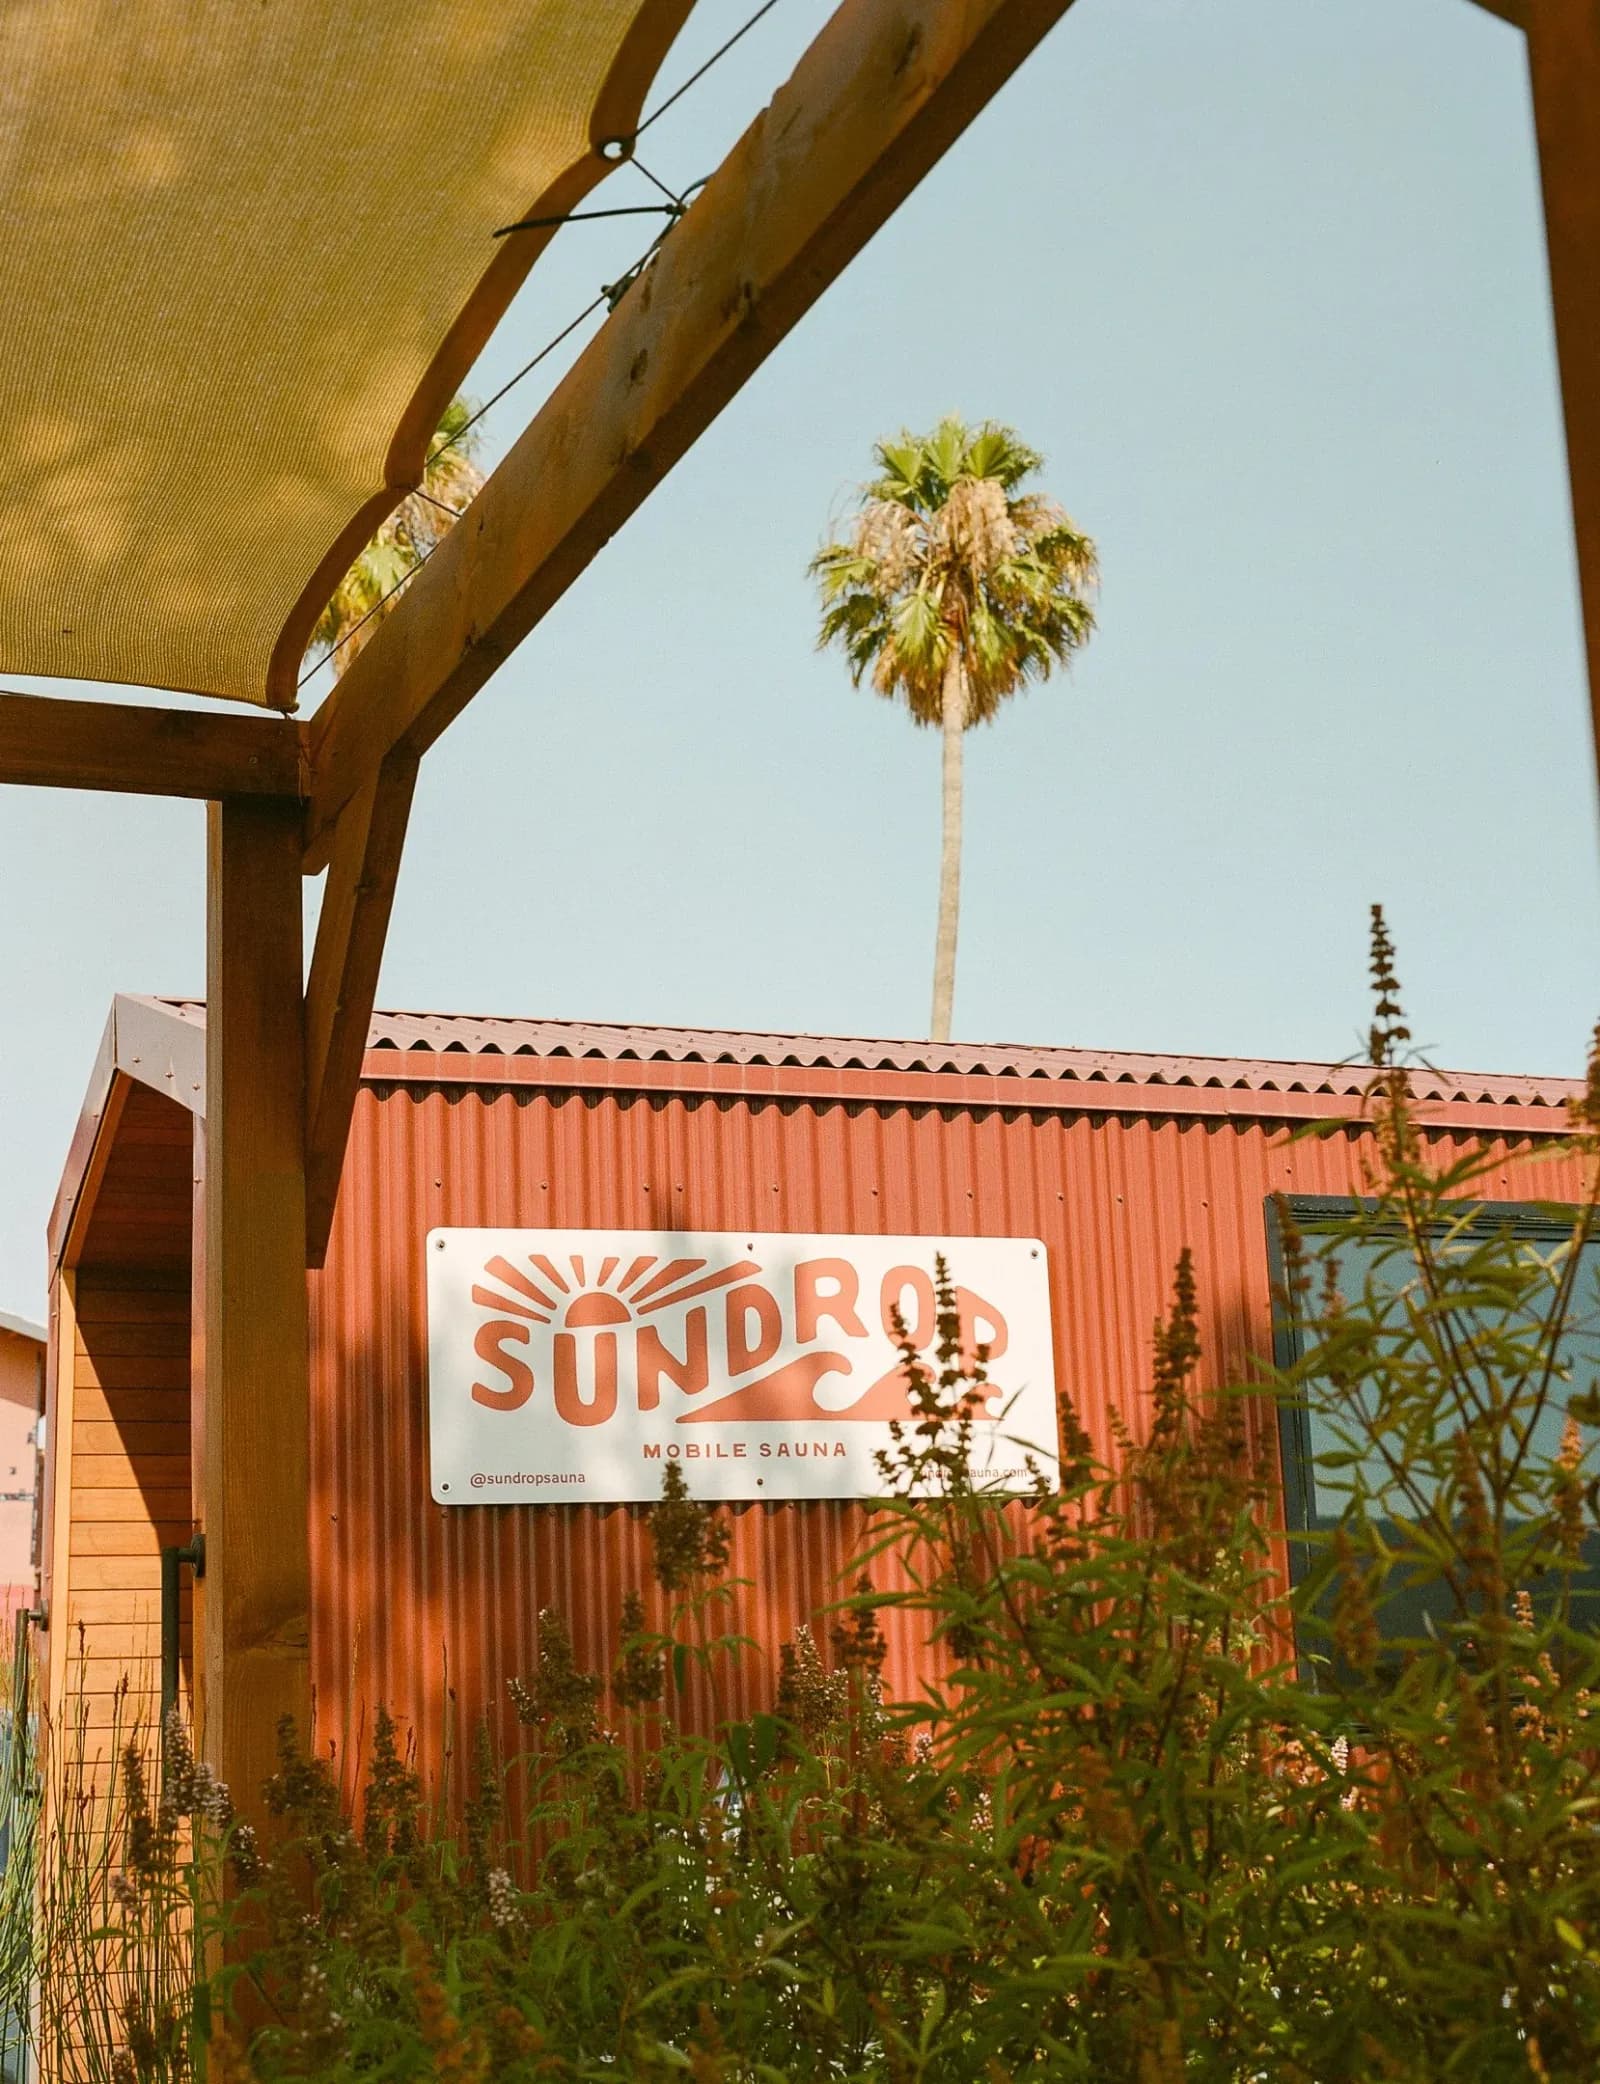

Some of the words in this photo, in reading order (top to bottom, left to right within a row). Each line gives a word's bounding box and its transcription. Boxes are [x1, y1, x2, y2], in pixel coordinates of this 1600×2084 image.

[471, 1257, 1008, 1426] SUNDROP
[643, 1443, 748, 1459] MOBILE
[759, 1442, 847, 1457] SAUNA
[470, 1472, 586, 1488] @sundropsauna
